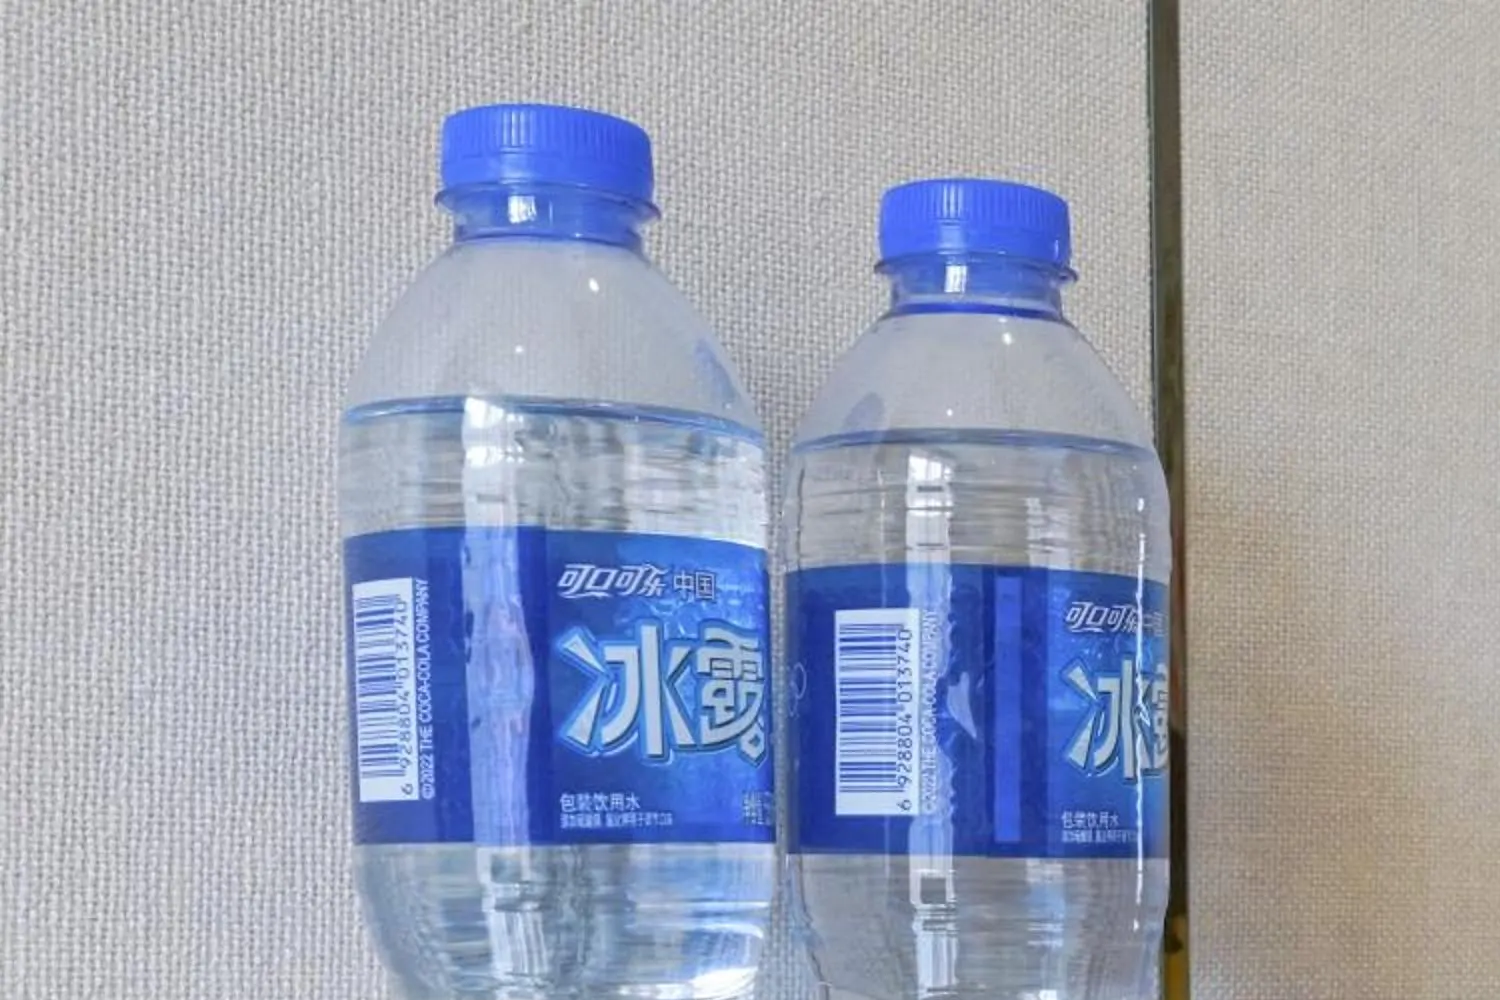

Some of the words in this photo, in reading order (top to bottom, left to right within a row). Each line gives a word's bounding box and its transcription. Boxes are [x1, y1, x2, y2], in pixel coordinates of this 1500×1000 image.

[415, 578, 431, 645] COMPANY
[673, 570, 716, 601] 中国
[395, 601, 411, 680] 013740
[897, 629, 913, 704] 013740
[417, 646, 433, 724] COCA-COLA
[560, 621, 767, 763] 冰露
[399, 691, 414, 769] 928804
[419, 725, 433, 751] THE
[897, 713, 913, 786] 928804
[400, 783, 414, 796] 6
[897, 799, 913, 811] 6
